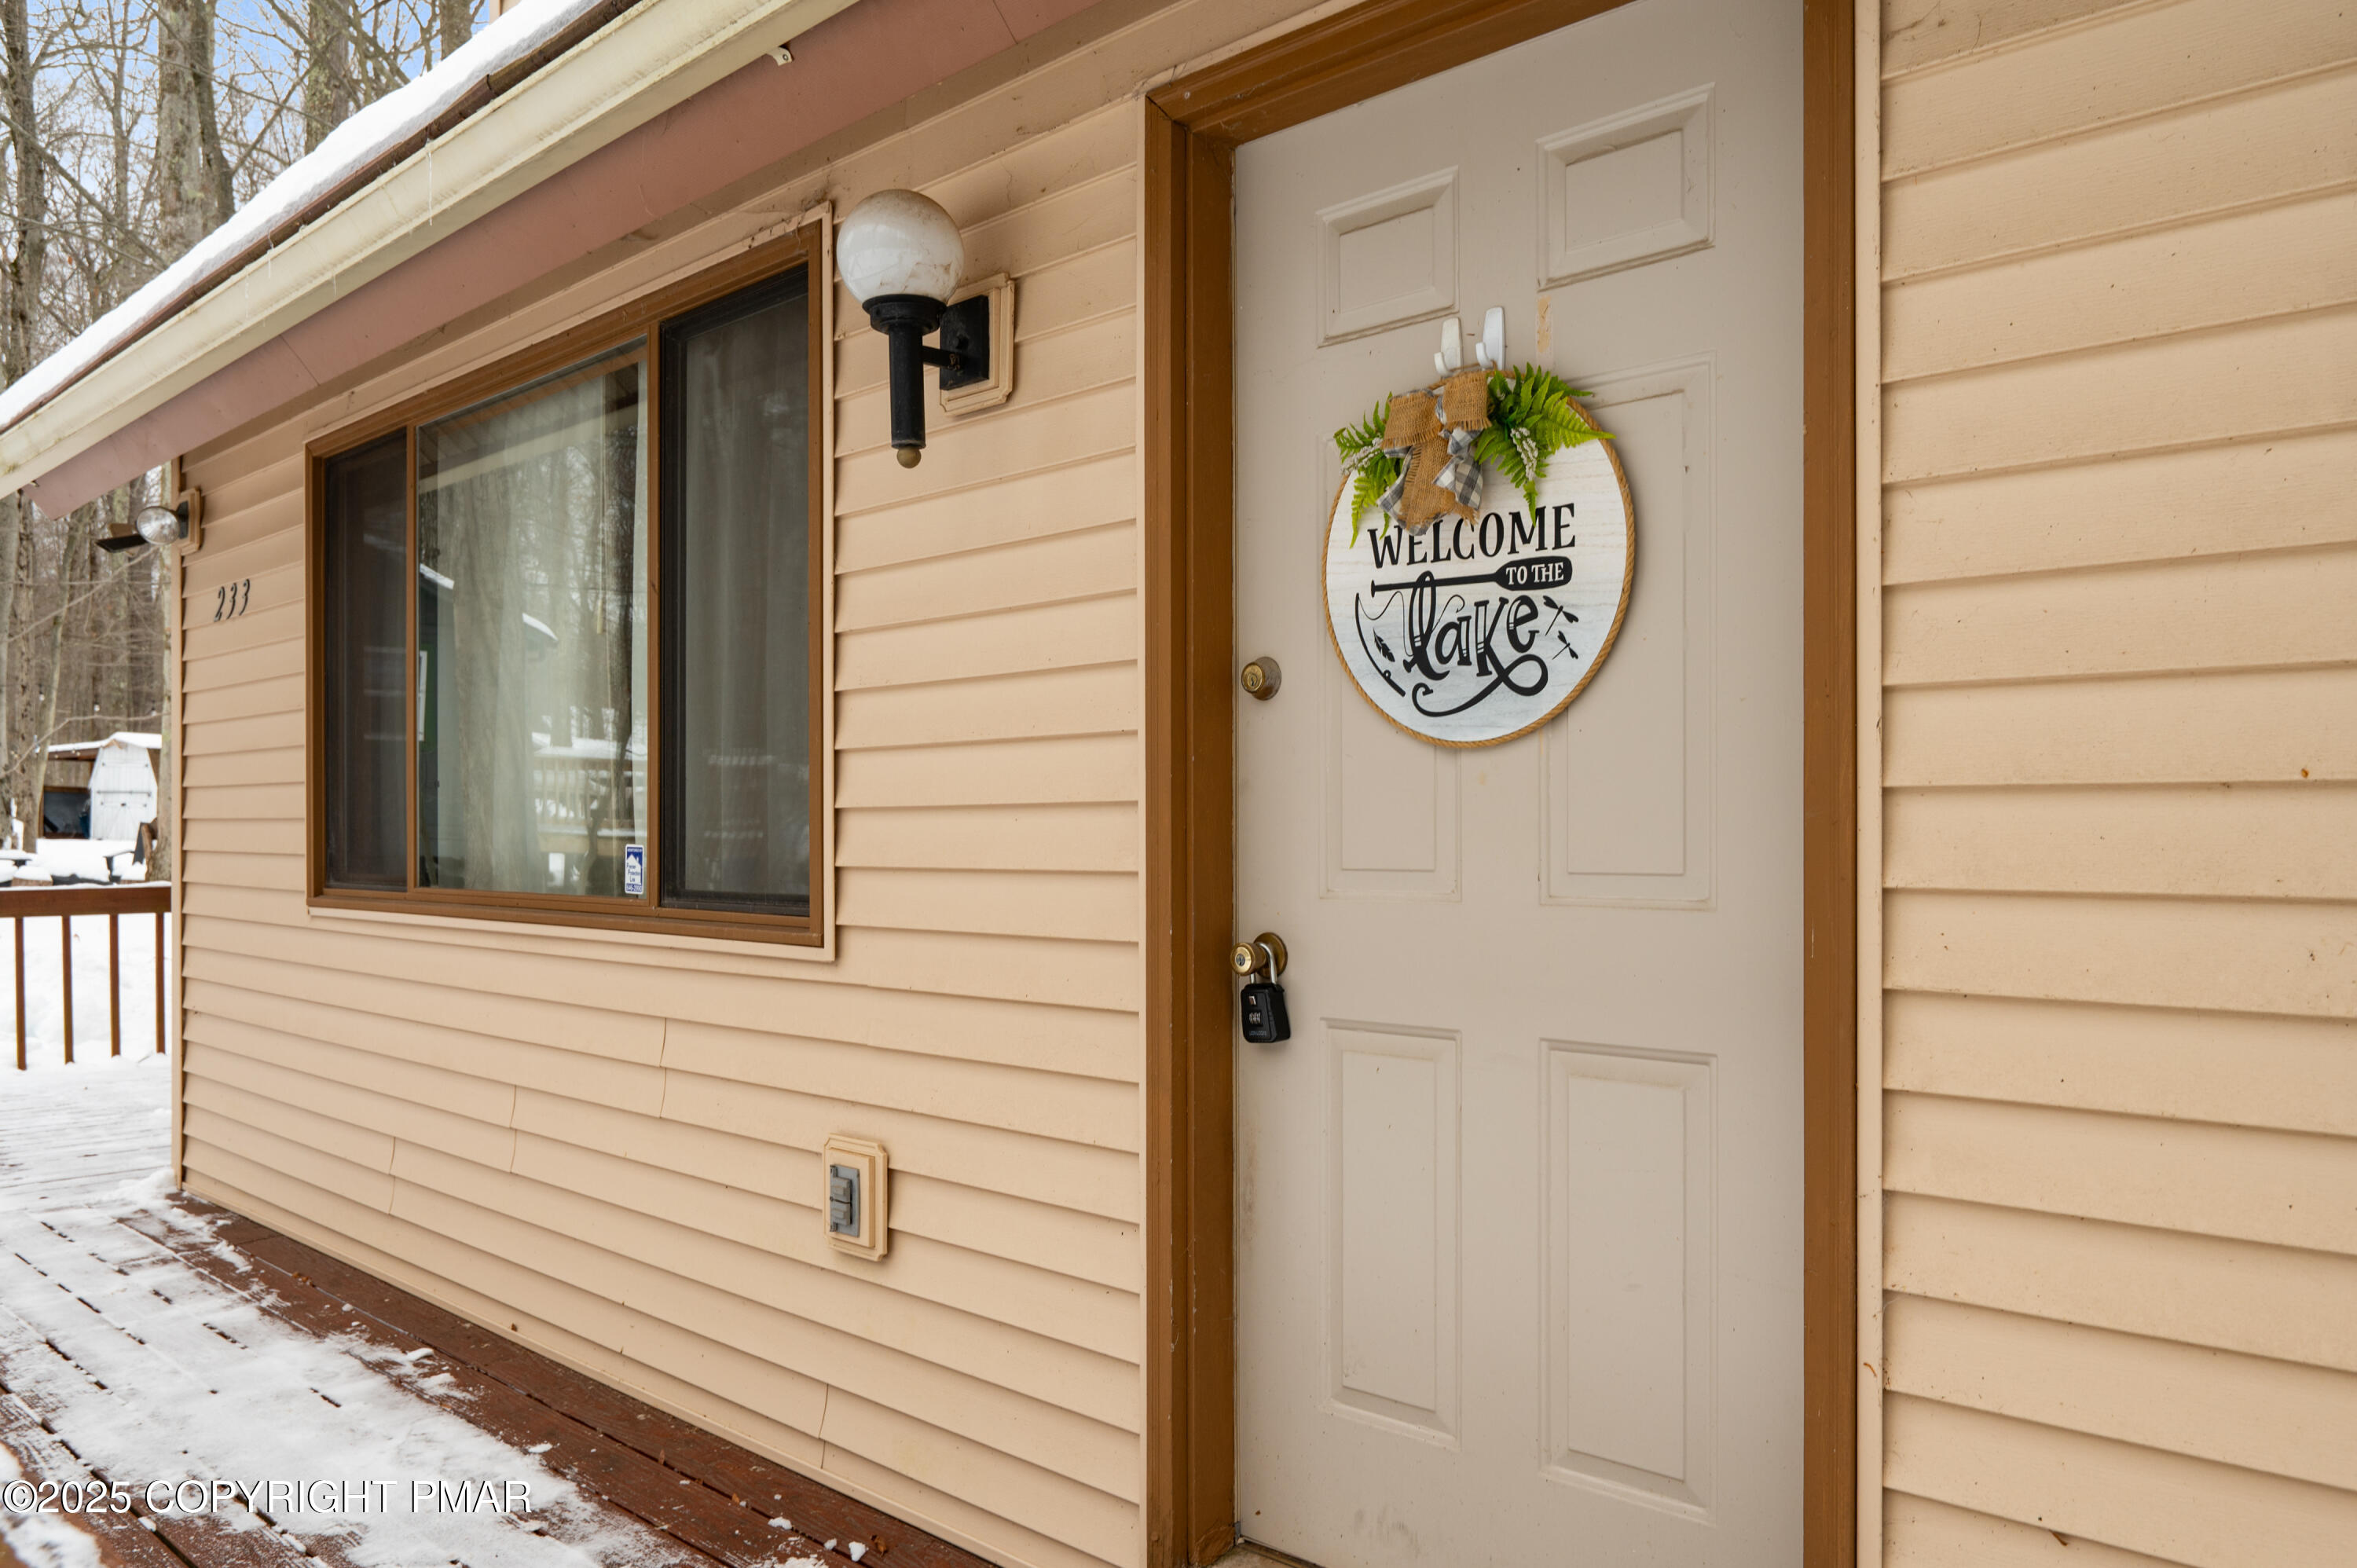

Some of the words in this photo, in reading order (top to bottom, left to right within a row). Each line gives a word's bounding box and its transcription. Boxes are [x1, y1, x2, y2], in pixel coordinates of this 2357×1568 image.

[1367, 503, 1576, 569] WELCOME
[1506, 566, 1528, 585] TO
[1531, 562, 1564, 584] THE
[214, 578, 250, 622] 233
